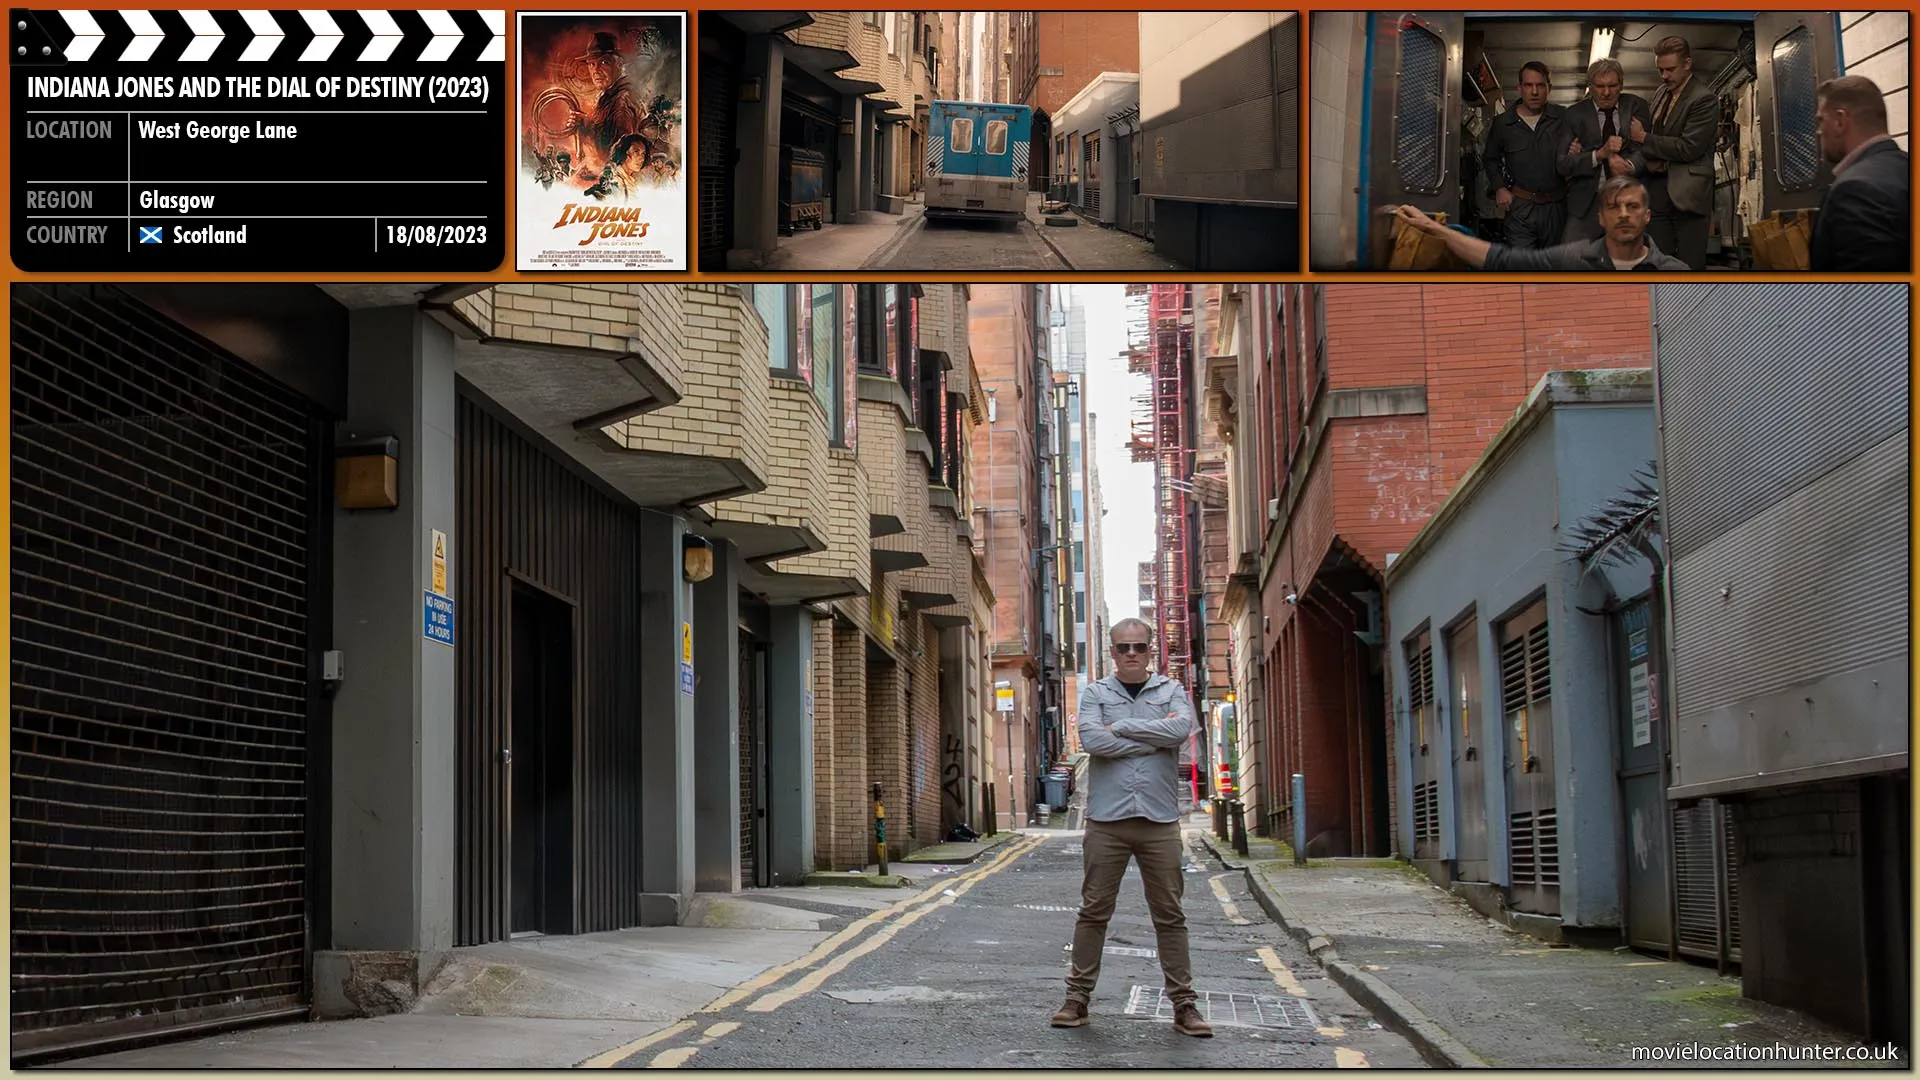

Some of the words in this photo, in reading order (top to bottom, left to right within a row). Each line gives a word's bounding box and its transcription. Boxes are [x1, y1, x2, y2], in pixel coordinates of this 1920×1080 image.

[553, 203, 642, 230] INDIANA
[578, 222, 650, 246] JONES
[426, 595, 433, 608] NO
[434, 598, 452, 614] PARKING
[428, 623, 435, 635] 24
[435, 626, 450, 640] HOURS
